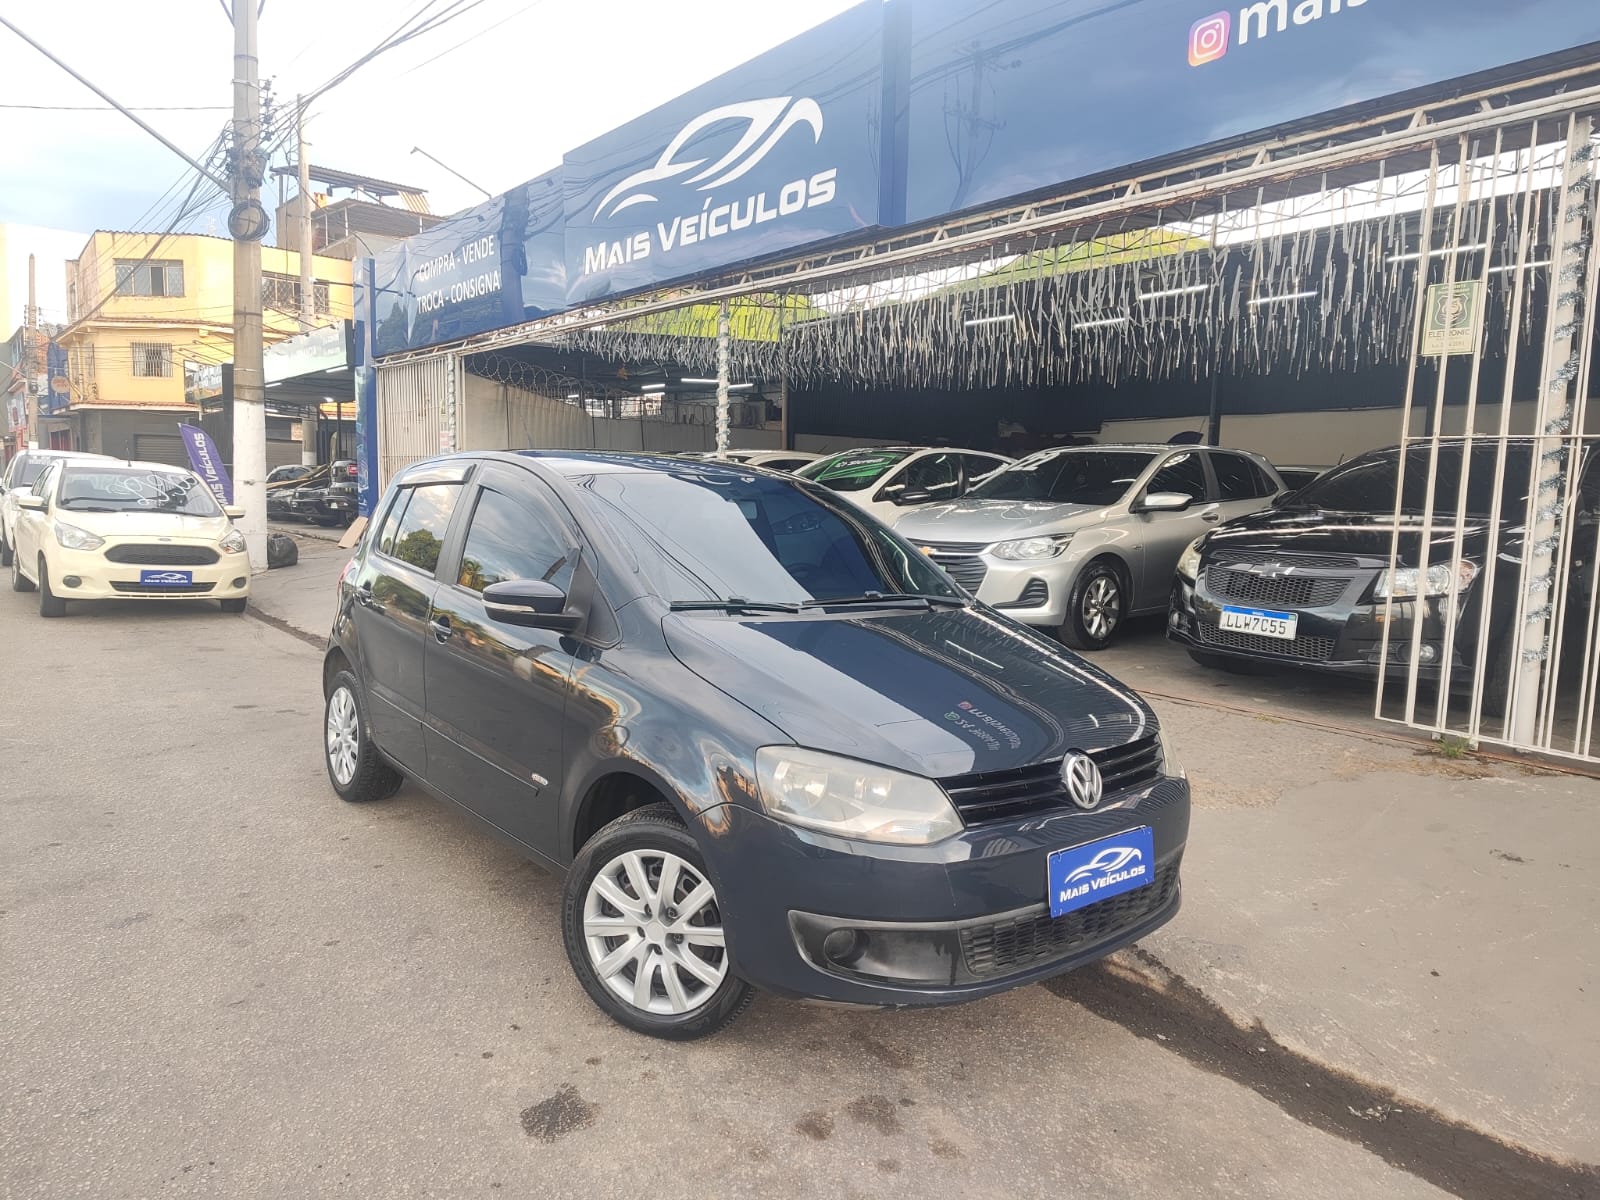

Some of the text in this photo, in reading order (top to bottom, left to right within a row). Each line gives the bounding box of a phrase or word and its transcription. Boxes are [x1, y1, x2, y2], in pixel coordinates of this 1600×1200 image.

[584, 167, 837, 275] MAIS VEÍCULOS
[419, 251, 456, 282] COMPRA
[462, 234, 495, 264] VENDE
[416, 289, 444, 314] TROCA
[450, 270, 500, 304] CONSIGNA
[1226, 614, 1286, 635] LLW7C55
[1060, 864, 1146, 903] MAIS VEÍCULOS
